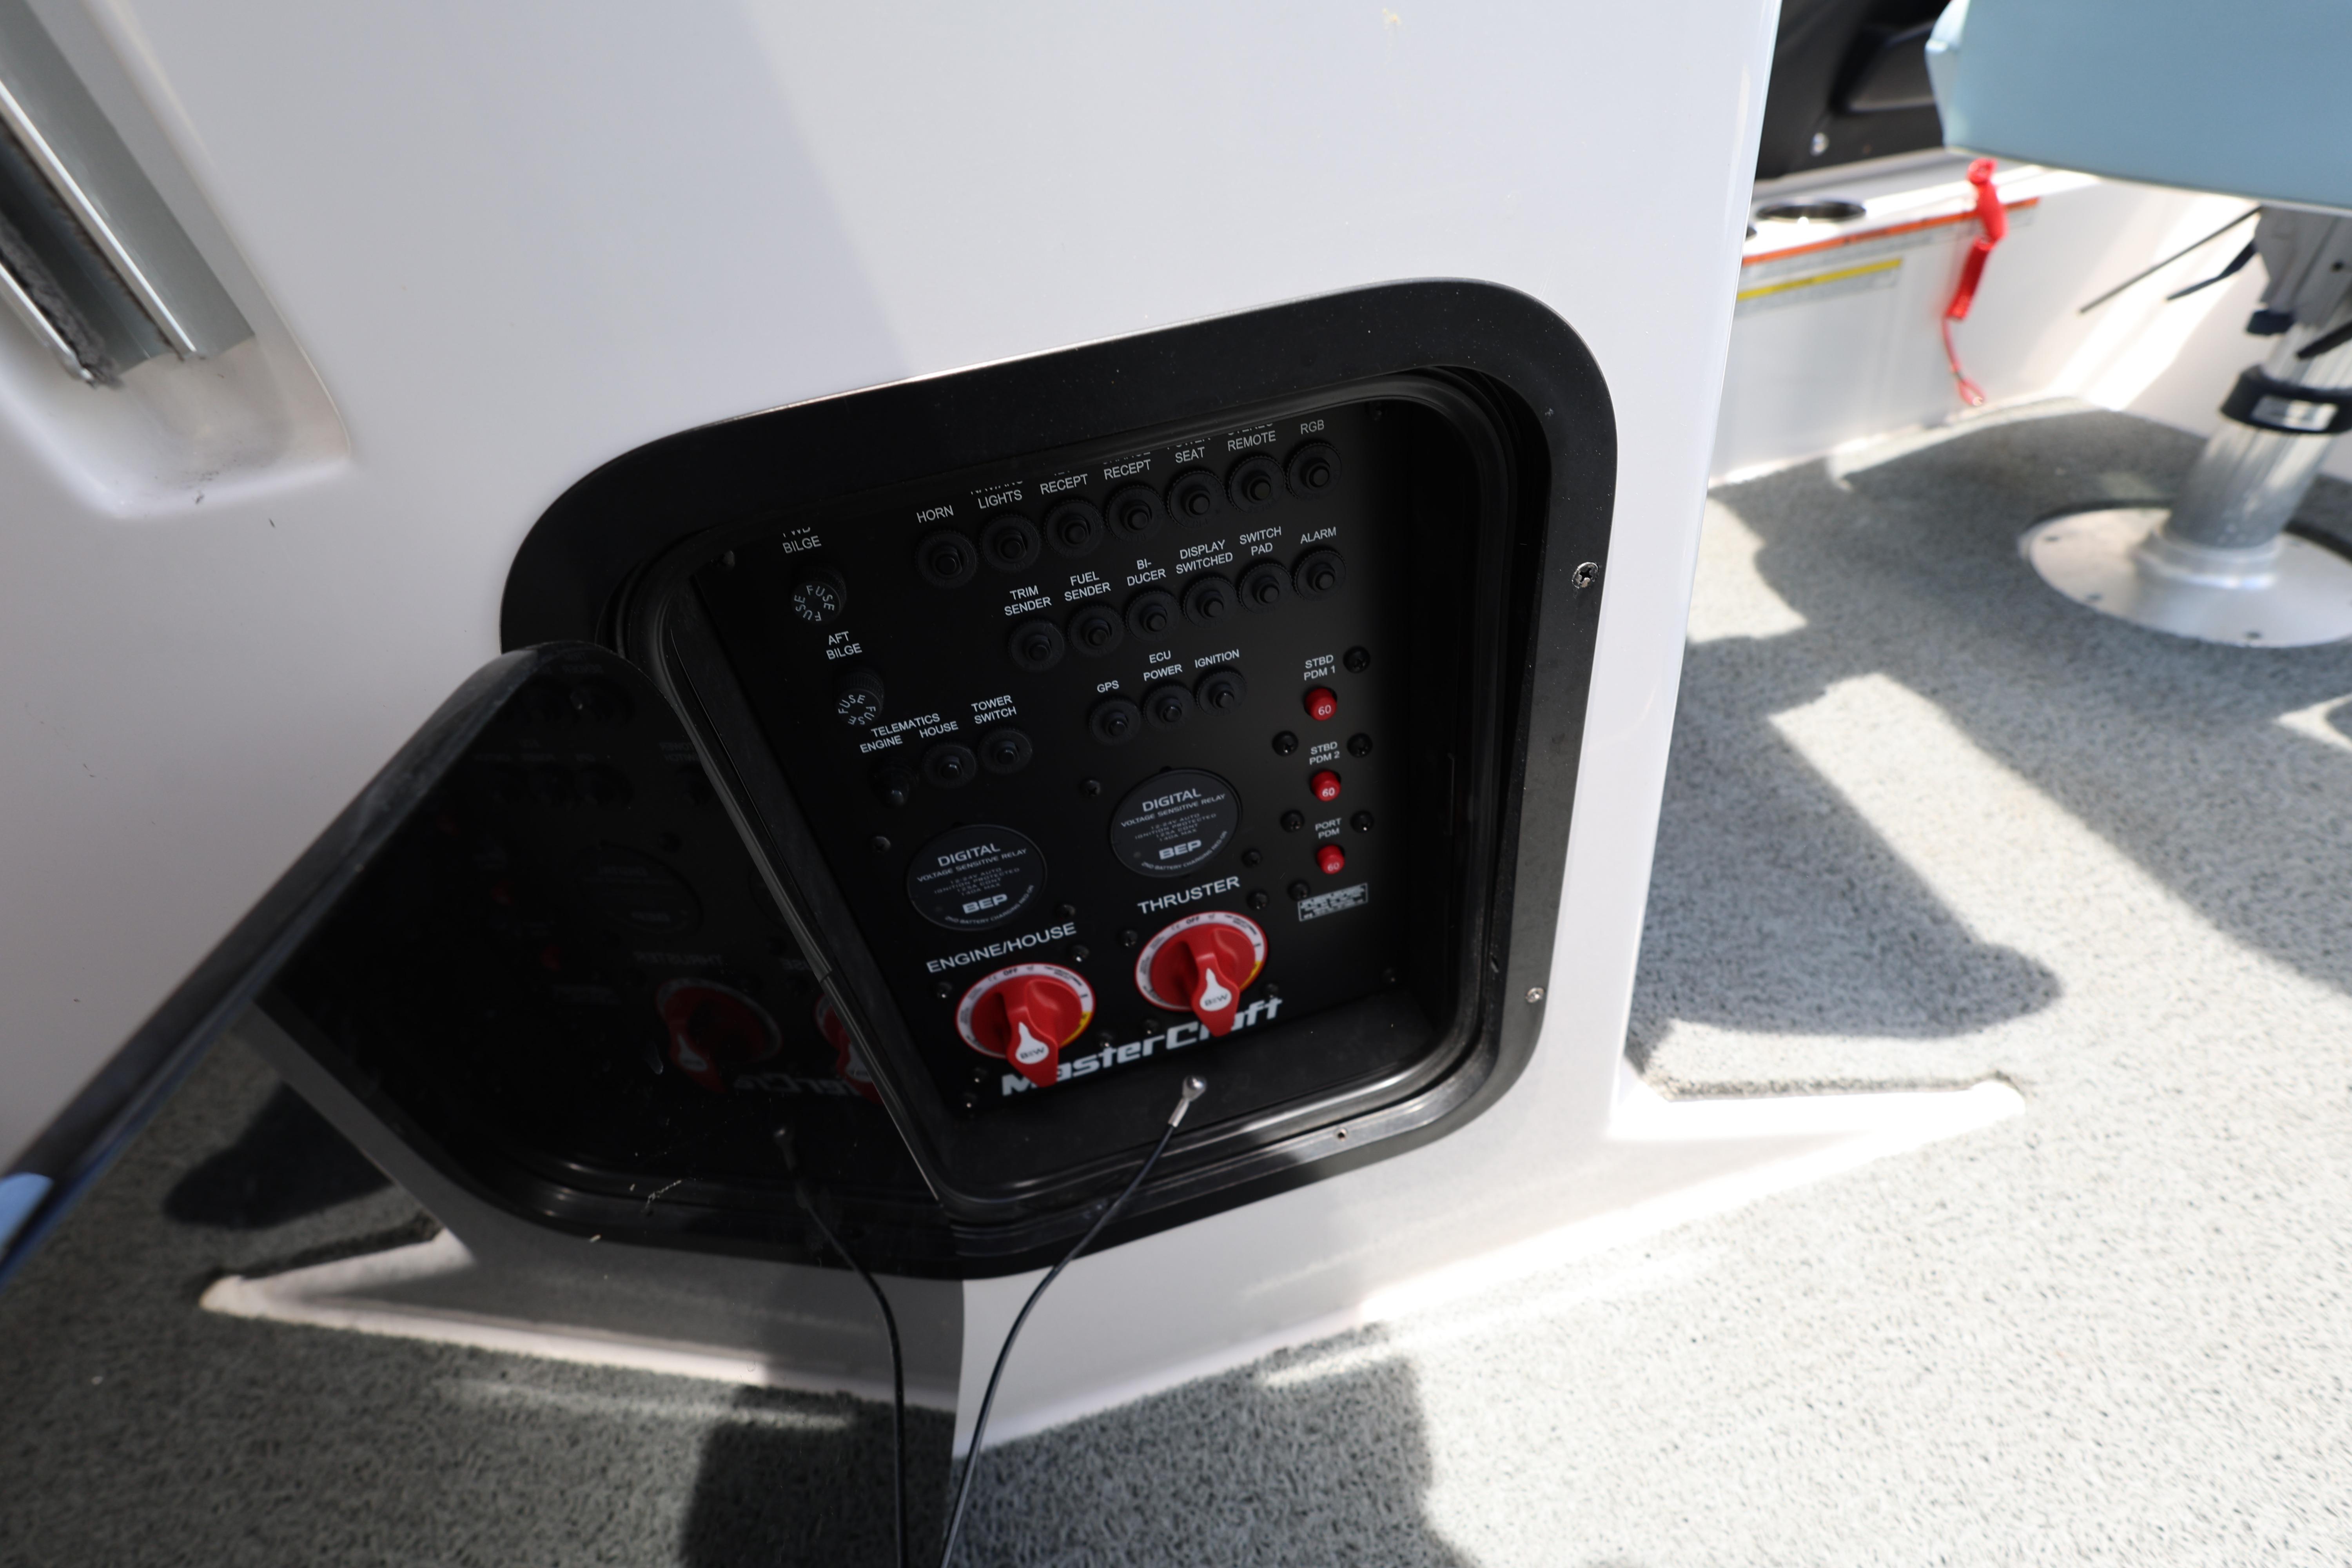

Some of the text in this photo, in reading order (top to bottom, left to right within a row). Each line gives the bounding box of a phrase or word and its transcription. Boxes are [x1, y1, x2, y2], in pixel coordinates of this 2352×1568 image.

[1300, 419, 1325, 435] RGB
[1227, 430, 1276, 452] REMOTE
[1175, 446, 1205, 463] SEAT
[1103, 459, 1151, 480] RECEPT
[1040, 473, 1088, 495] RECEPT
[978, 489, 1022, 509] LIGHTS
[916, 505, 954, 523] HORN
[1240, 526, 1281, 544] SWITCH
[1300, 526, 1336, 544] ALARM
[782, 535, 822, 554] BILGE
[1180, 539, 1225, 559] DISPLAY
[1251, 542, 1273, 556] PAD
[1136, 558, 1152, 570] BI-
[1176, 552, 1233, 574] SWITCHED
[1070, 571, 1100, 586] FUEL
[1127, 568, 1166, 586] DUCER
[806, 584, 835, 611] FUSE
[1009, 585, 1039, 600] TRIM
[1064, 582, 1111, 601] SENDER
[794, 595, 822, 622] FUSE
[1004, 596, 1052, 616] SENDER
[829, 631, 849, 645] AFT
[826, 643, 862, 660] BILGE
[1149, 650, 1171, 664] ECU
[1194, 649, 1240, 668] IGNITION
[1305, 654, 1334, 669] STBD
[1143, 664, 1183, 681] POWER
[1304, 665, 1335, 681] PDM 1
[1097, 680, 1119, 693] GPS
[838, 694, 866, 715] FUSE
[971, 695, 1013, 712] TOWER
[1318, 705, 1332, 715] 60
[848, 706, 876, 725] FUSE
[974, 706, 1017, 724] SWITCH
[871, 713, 940, 737] TELEMATICS
[860, 720, 958, 753] ENGINE HOUSE
[1310, 741, 1338, 755] STBD
[1309, 751, 1340, 765] PDM 2
[1142, 788, 1201, 812] DIGITAL
[1322, 787, 1335, 797] 60
[1121, 793, 1225, 828] VOLTAGE SENSITIVE RELAY
[1180, 813, 1200, 822] AUTO
[1315, 818, 1341, 831] PORT
[1318, 827, 1340, 839] PDM
[938, 843, 1001, 867] DIGITAL
[1159, 839, 1201, 860] BEP
[916, 848, 1027, 882] VOLTAGE SENSITIVE RELAY
[1327, 862, 1340, 872] 60
[962, 894, 1007, 914] BEP
[1137, 876, 1240, 914] THRUSTER
[926, 922, 1076, 973] ENGINE/HOUSE
[1003, 967, 1018, 976] OFF
